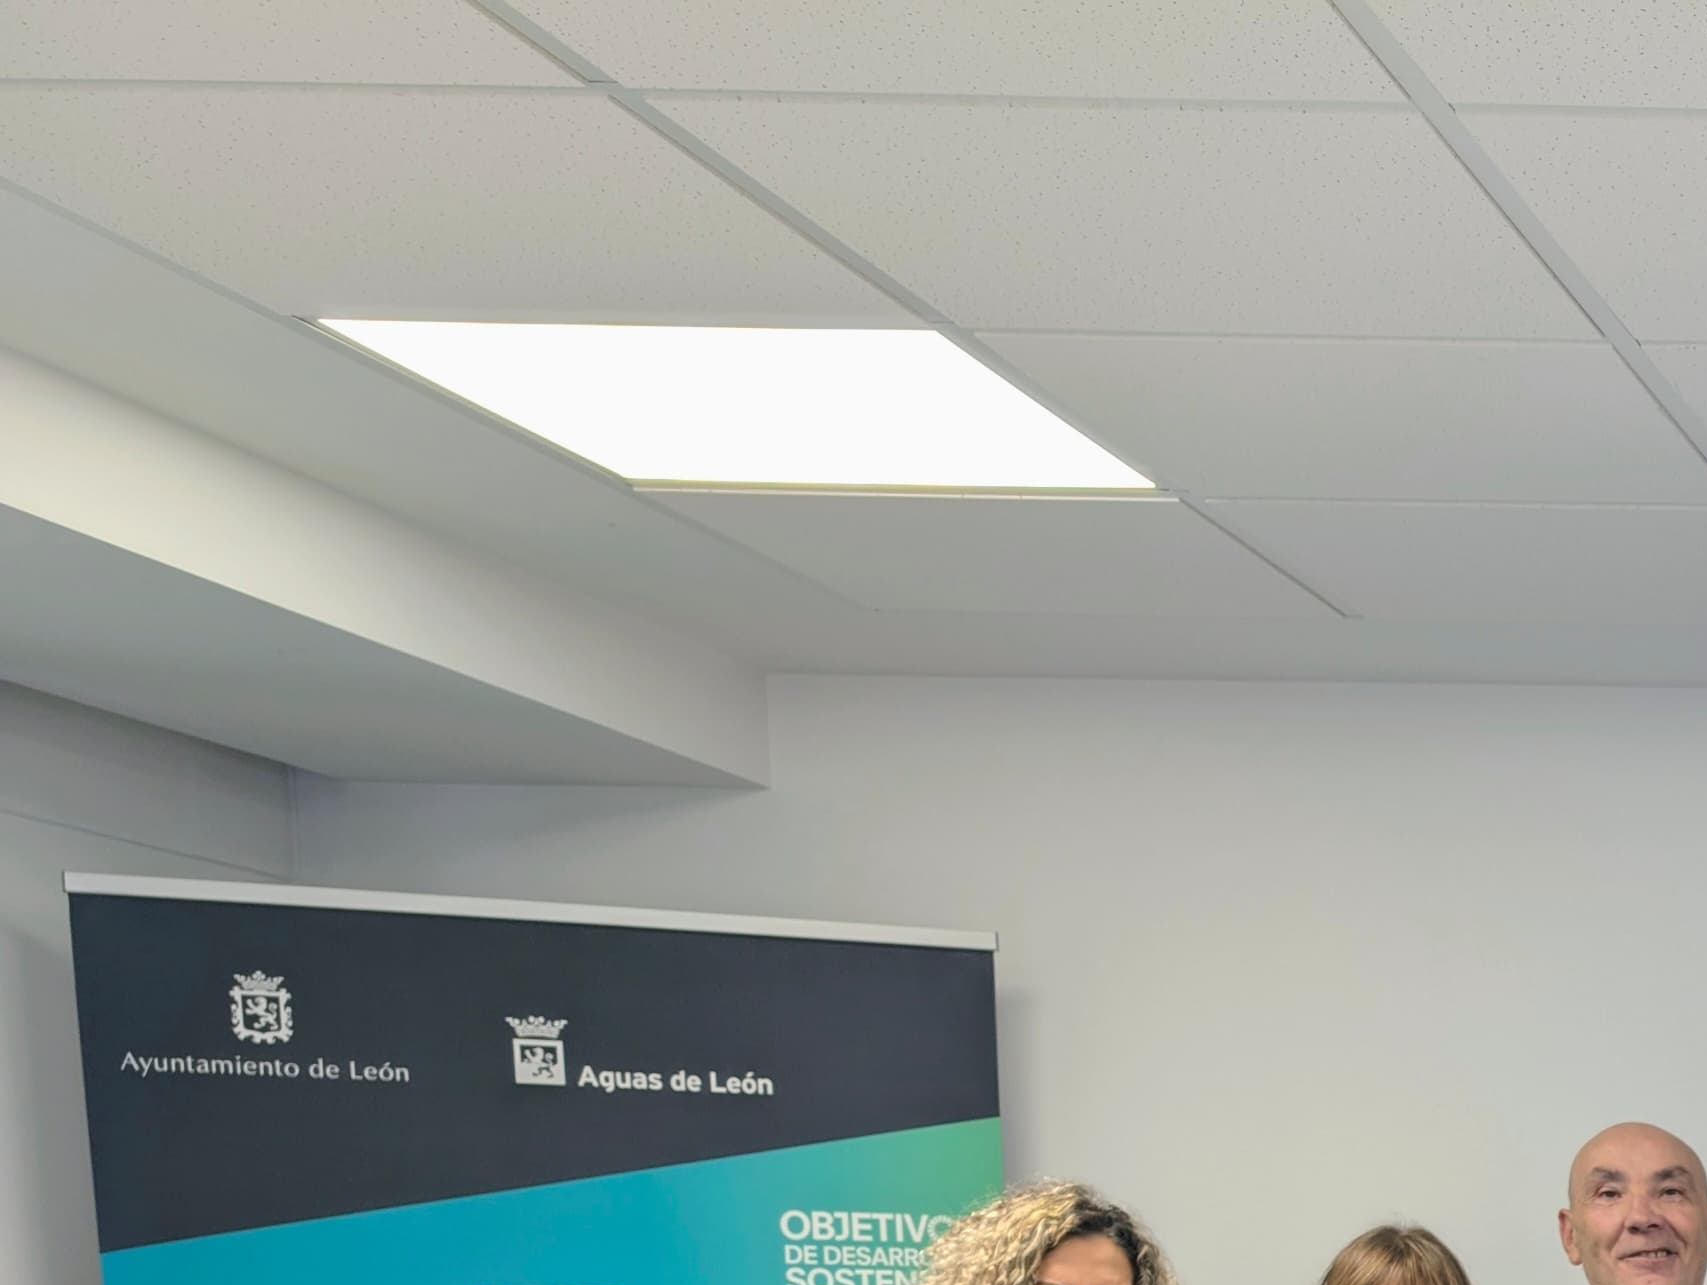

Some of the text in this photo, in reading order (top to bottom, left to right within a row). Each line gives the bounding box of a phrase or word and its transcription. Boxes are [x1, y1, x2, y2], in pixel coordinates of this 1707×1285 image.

[120, 1051, 410, 1082] Ayuntamiento de León
[577, 1065, 774, 1096] Aguas de León
[784, 1244, 818, 1265] DE
